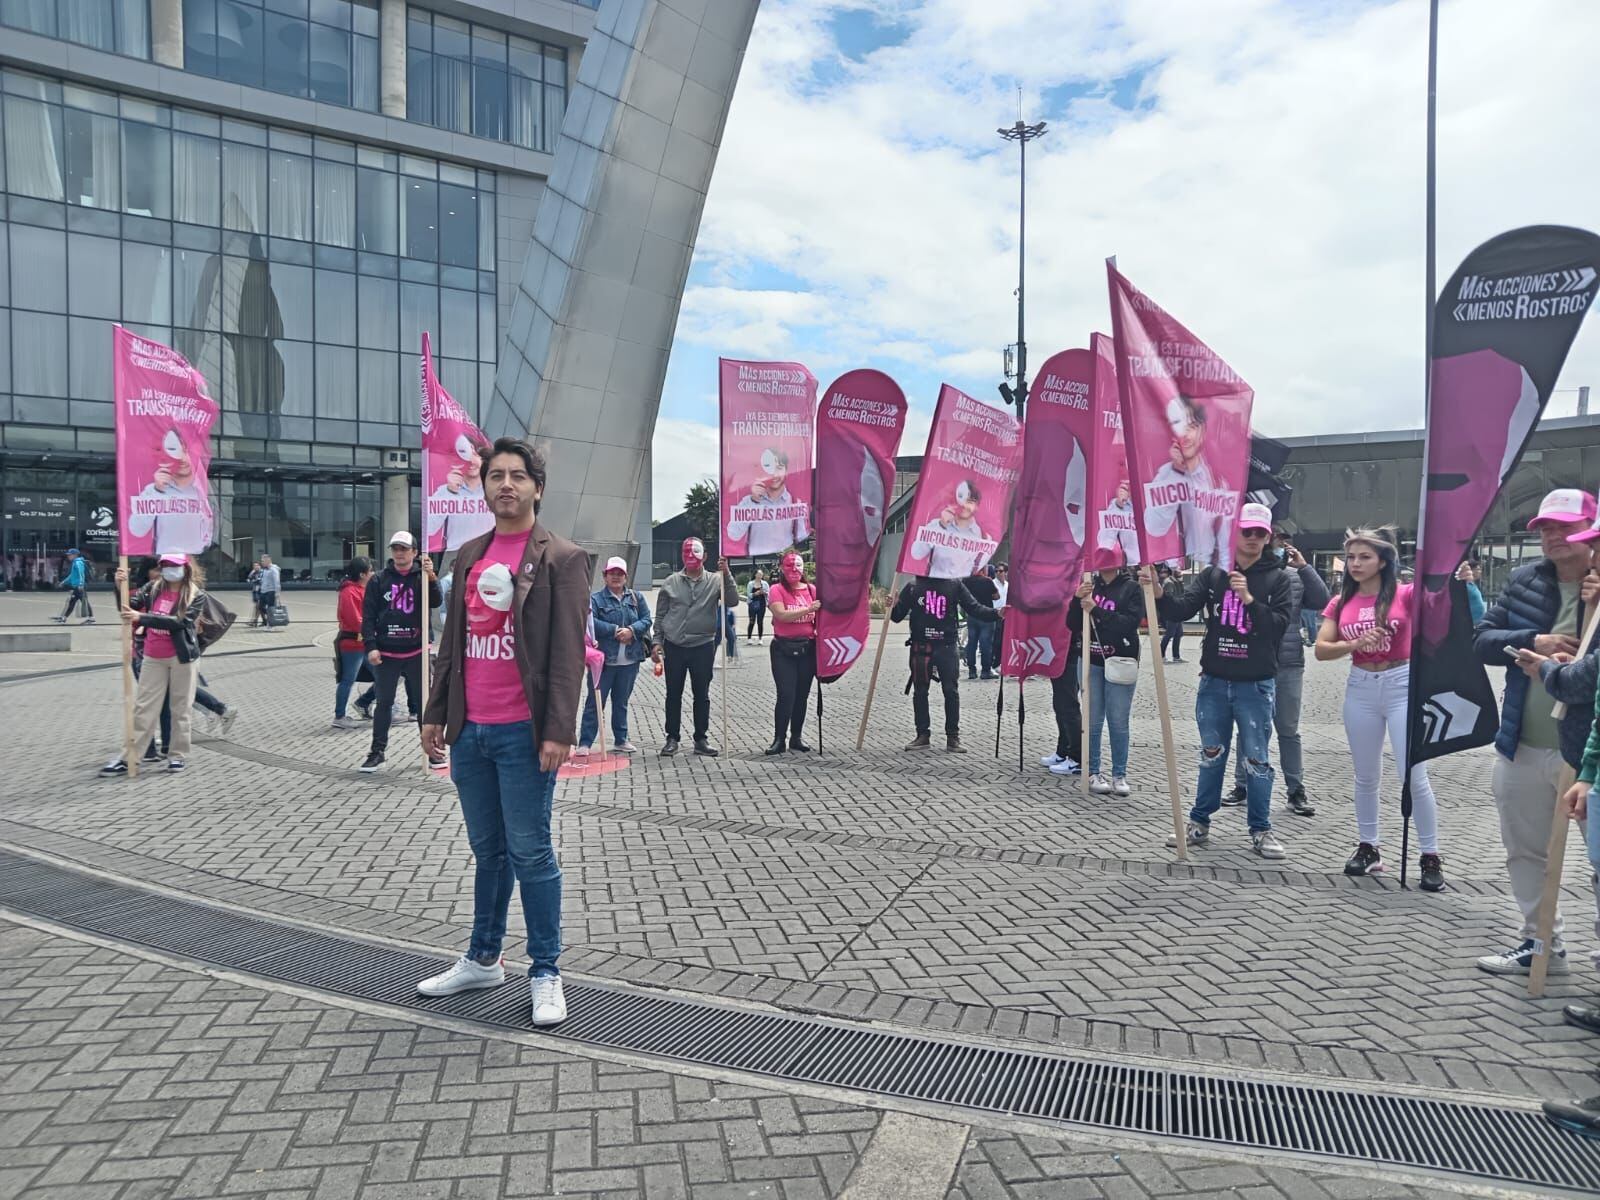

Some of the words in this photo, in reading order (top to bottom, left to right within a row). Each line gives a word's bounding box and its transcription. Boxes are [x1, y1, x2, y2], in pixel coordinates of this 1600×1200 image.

[1492, 271, 1560, 297] ACCIONES
[1466, 301, 1514, 321] MENOS
[746, 381, 772, 394] MENOS
[1043, 373, 1064, 391] MÁS
[1064, 381, 1089, 395] ACCION
[830, 392, 850, 409] MÁS
[850, 398, 883, 412] ACCIONES
[1047, 391, 1074, 406] MENOS
[834, 408, 860, 421] MENOS
[1149, 482, 1194, 507] NICOL
[429, 496, 476, 515] NICOLÁS
[734, 504, 774, 522] NICOLÁS
[919, 528, 962, 549] NICOLÁS
[961, 537, 997, 555] RAMOS
